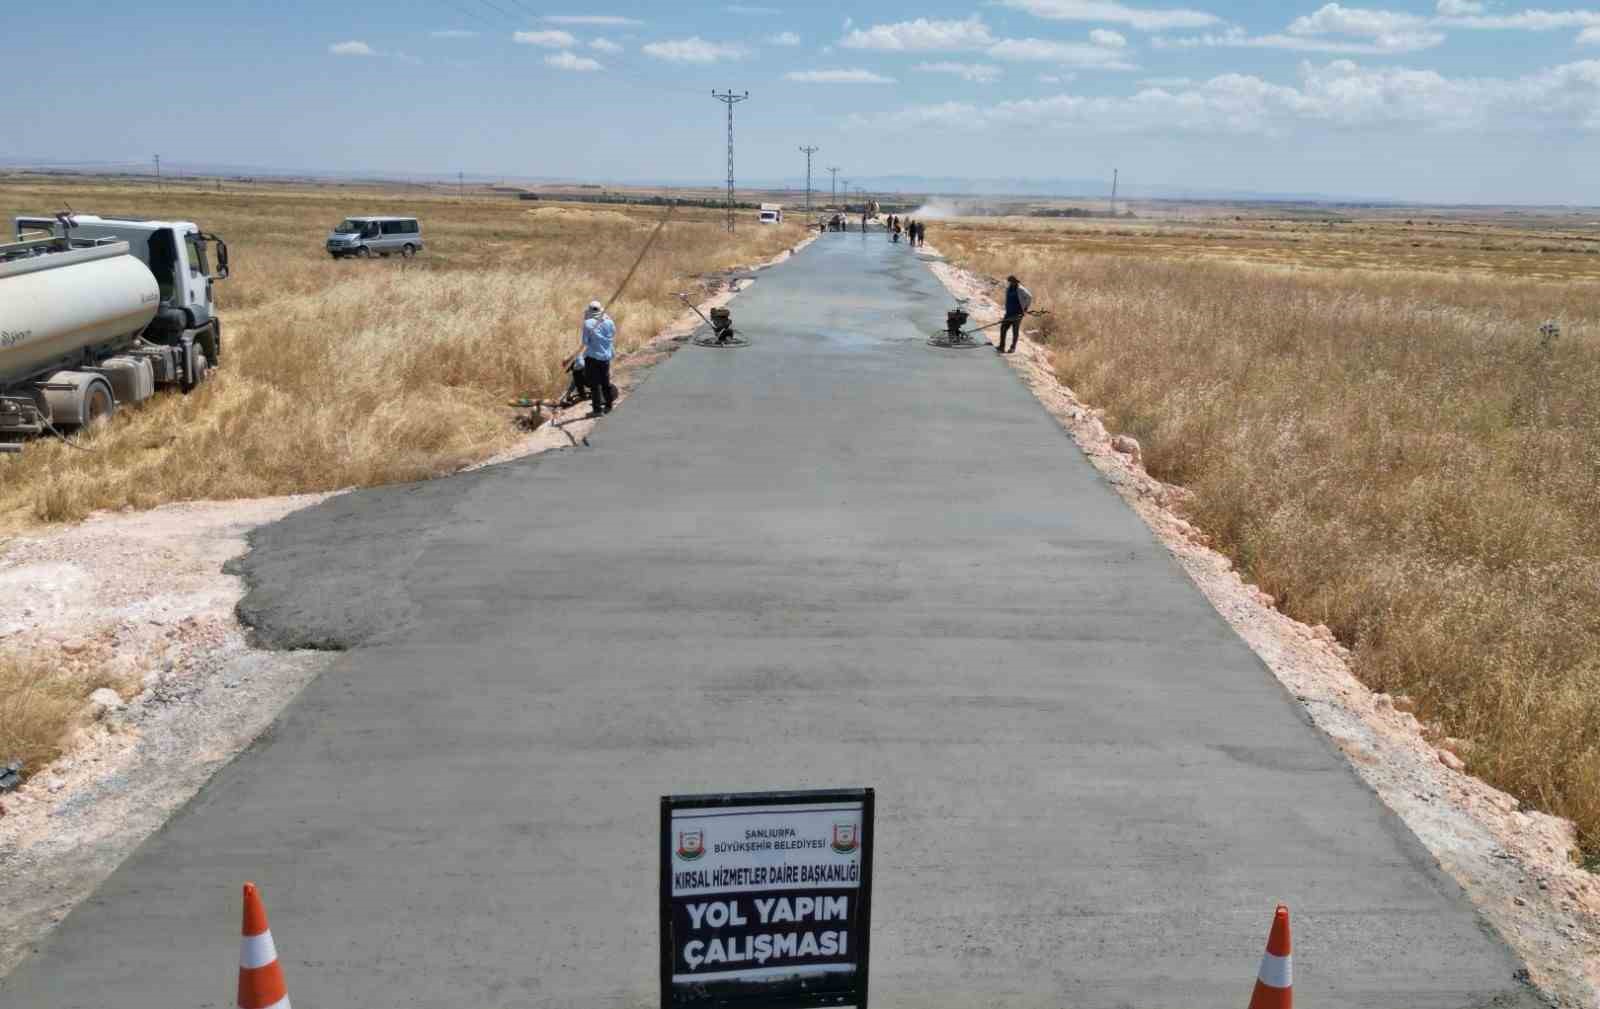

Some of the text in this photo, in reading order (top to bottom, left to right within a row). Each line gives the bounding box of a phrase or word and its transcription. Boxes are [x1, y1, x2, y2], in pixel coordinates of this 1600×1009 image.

[714, 839, 826, 853] BÜYÜKŞEHİR BELEDİYESİ
[745, 828, 796, 840] ŞANLIURFA
[675, 860, 859, 889] KIRSAL HİZMETLER DAİRE BAŞKANLIĞI
[685, 896, 848, 929] YOL YAPIM
[683, 930, 848, 970] ÇALIŞMASI
